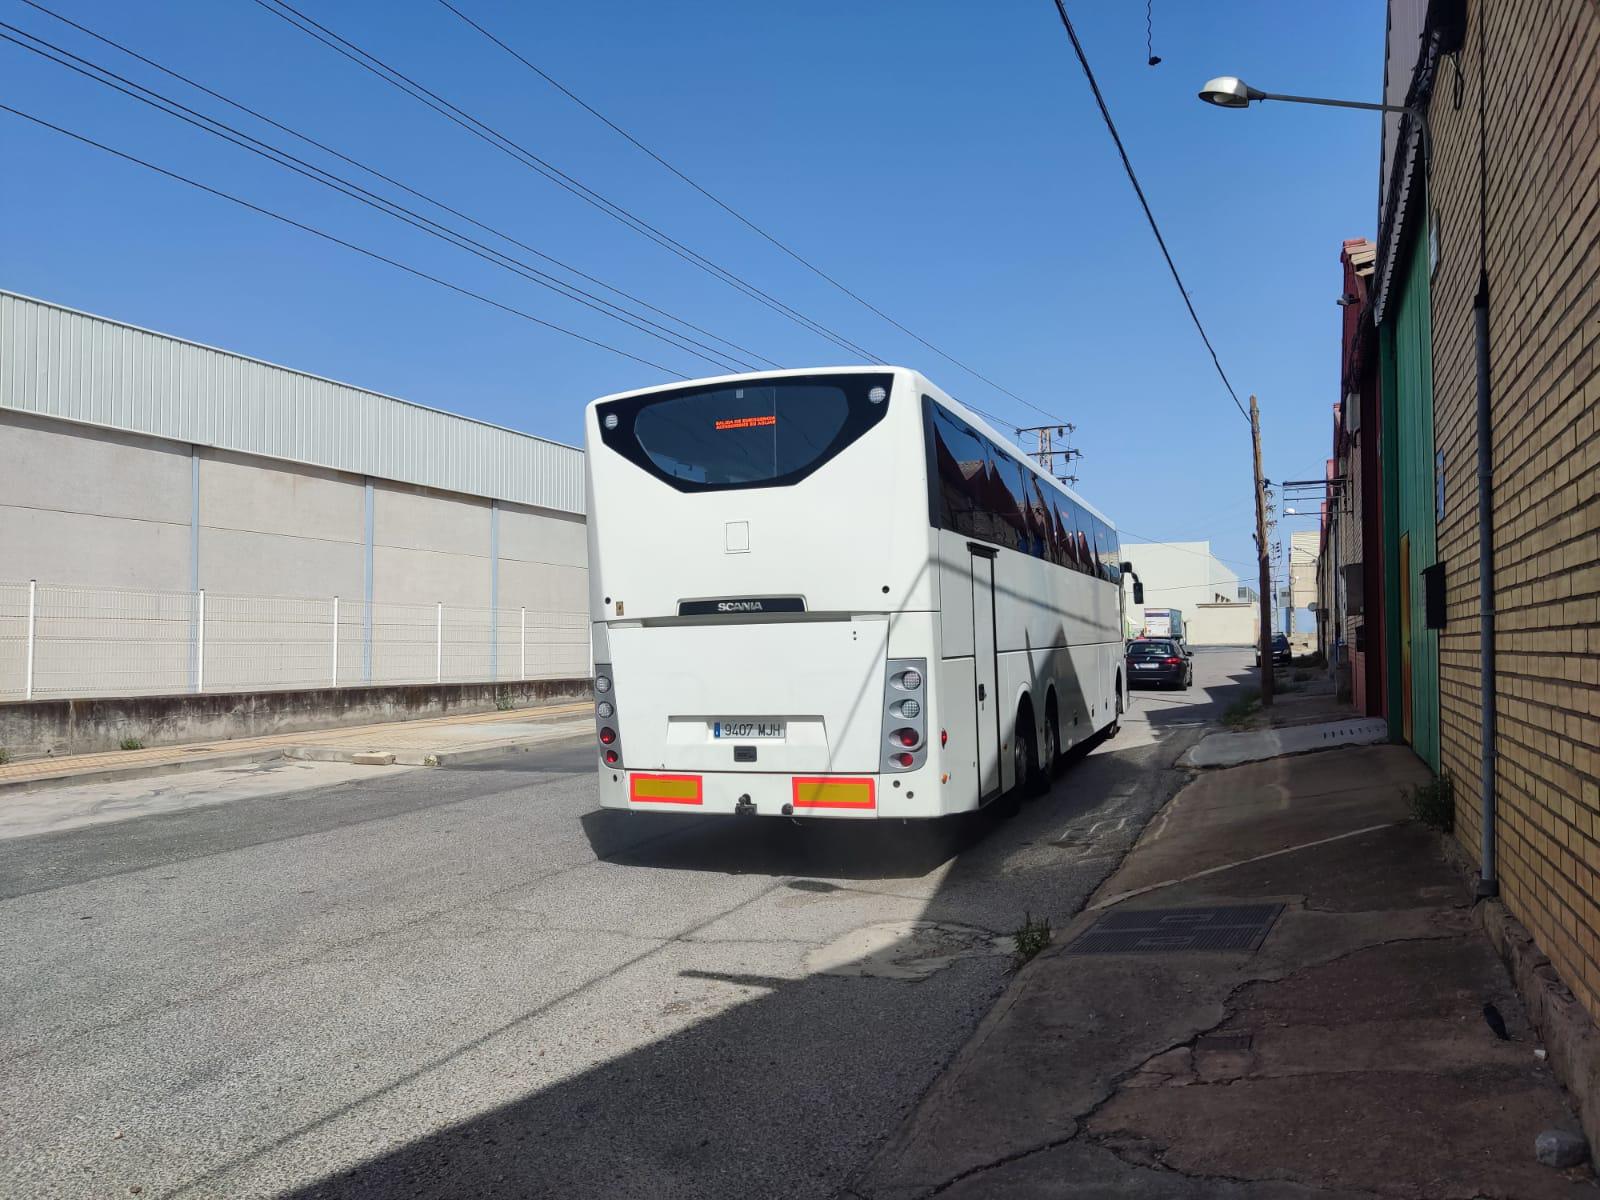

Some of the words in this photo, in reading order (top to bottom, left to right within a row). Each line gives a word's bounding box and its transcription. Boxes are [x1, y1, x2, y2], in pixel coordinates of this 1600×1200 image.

[718, 602, 763, 611] SCANIA
[724, 723, 754, 737] 9407
[758, 723, 781, 737] MJH
